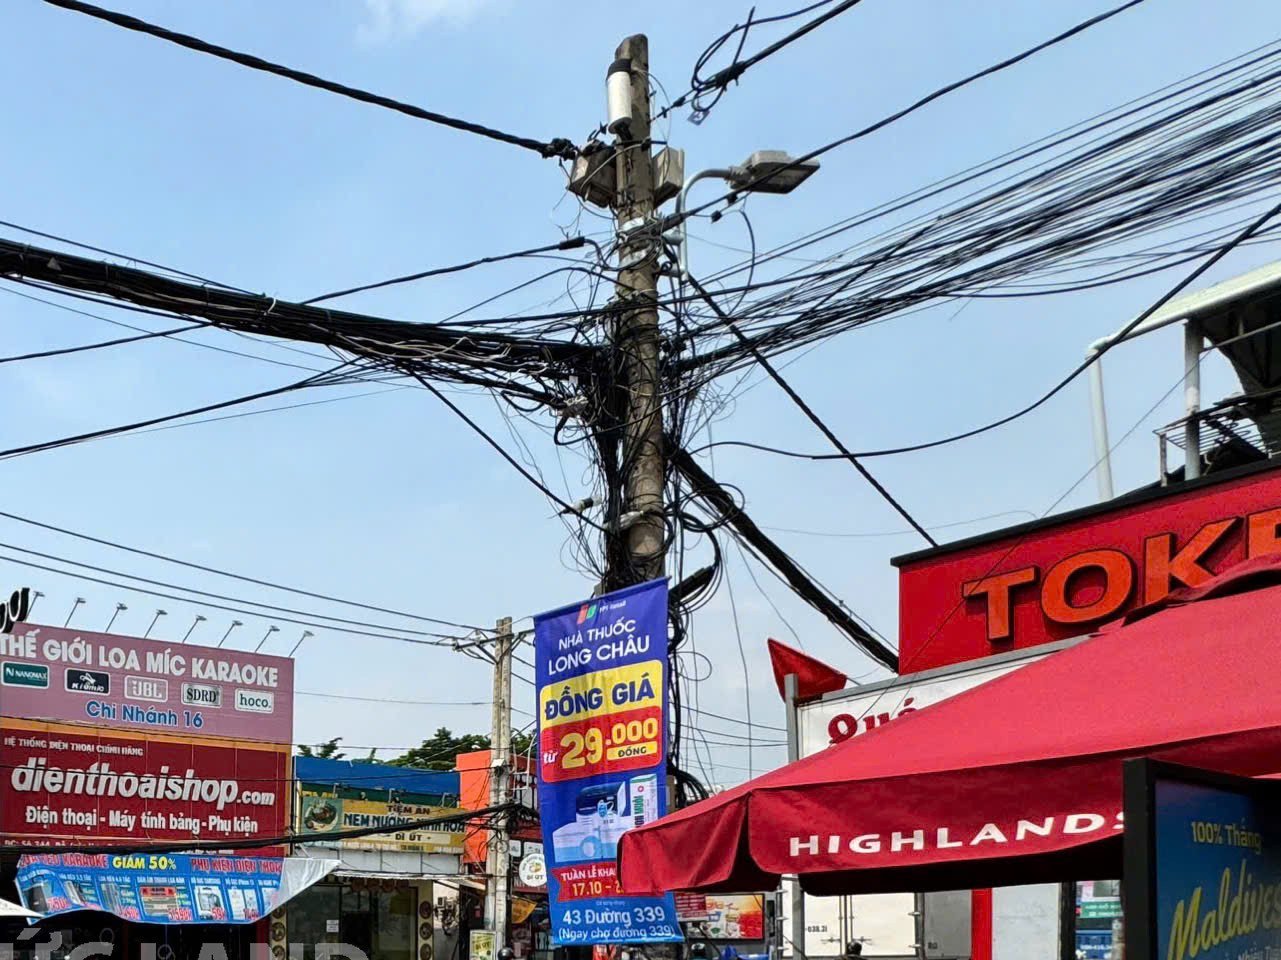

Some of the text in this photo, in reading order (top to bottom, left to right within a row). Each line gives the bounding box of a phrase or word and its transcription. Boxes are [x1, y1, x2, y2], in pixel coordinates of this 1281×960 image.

[962, 508, 1281, 640] TOK
[559, 617, 636, 650] NHÀ THUỐC
[0, 629, 278, 687] THẾ GIỚI LOA MÍC KARAOKE
[548, 634, 650, 675] LONG CHÂU
[132, 681, 162, 698] JBL
[186, 688, 218, 704] SDRD
[545, 672, 655, 720] ĐỒNG GIÁ
[86, 700, 204, 728] Chi Nhánh 16
[543, 718, 659, 769] từ 29.000
[26, 806, 57, 829] Điện
[62, 808, 97, 831] thoại
[109, 809, 136, 832] Máy
[141, 811, 166, 830] tính
[169, 813, 200, 834] bảng
[208, 816, 231, 836] Phụ
[233, 816, 258, 836] kiện
[344, 814, 369, 827] NEM
[1191, 821, 1223, 845] 100%
[149, 856, 177, 870] 50%
[598, 868, 617, 878] KHA
[572, 881, 602, 896] 17.10
[563, 906, 665, 928] 43 Đường 339
[558, 925, 675, 942] (Ngay chợ đường 339)
